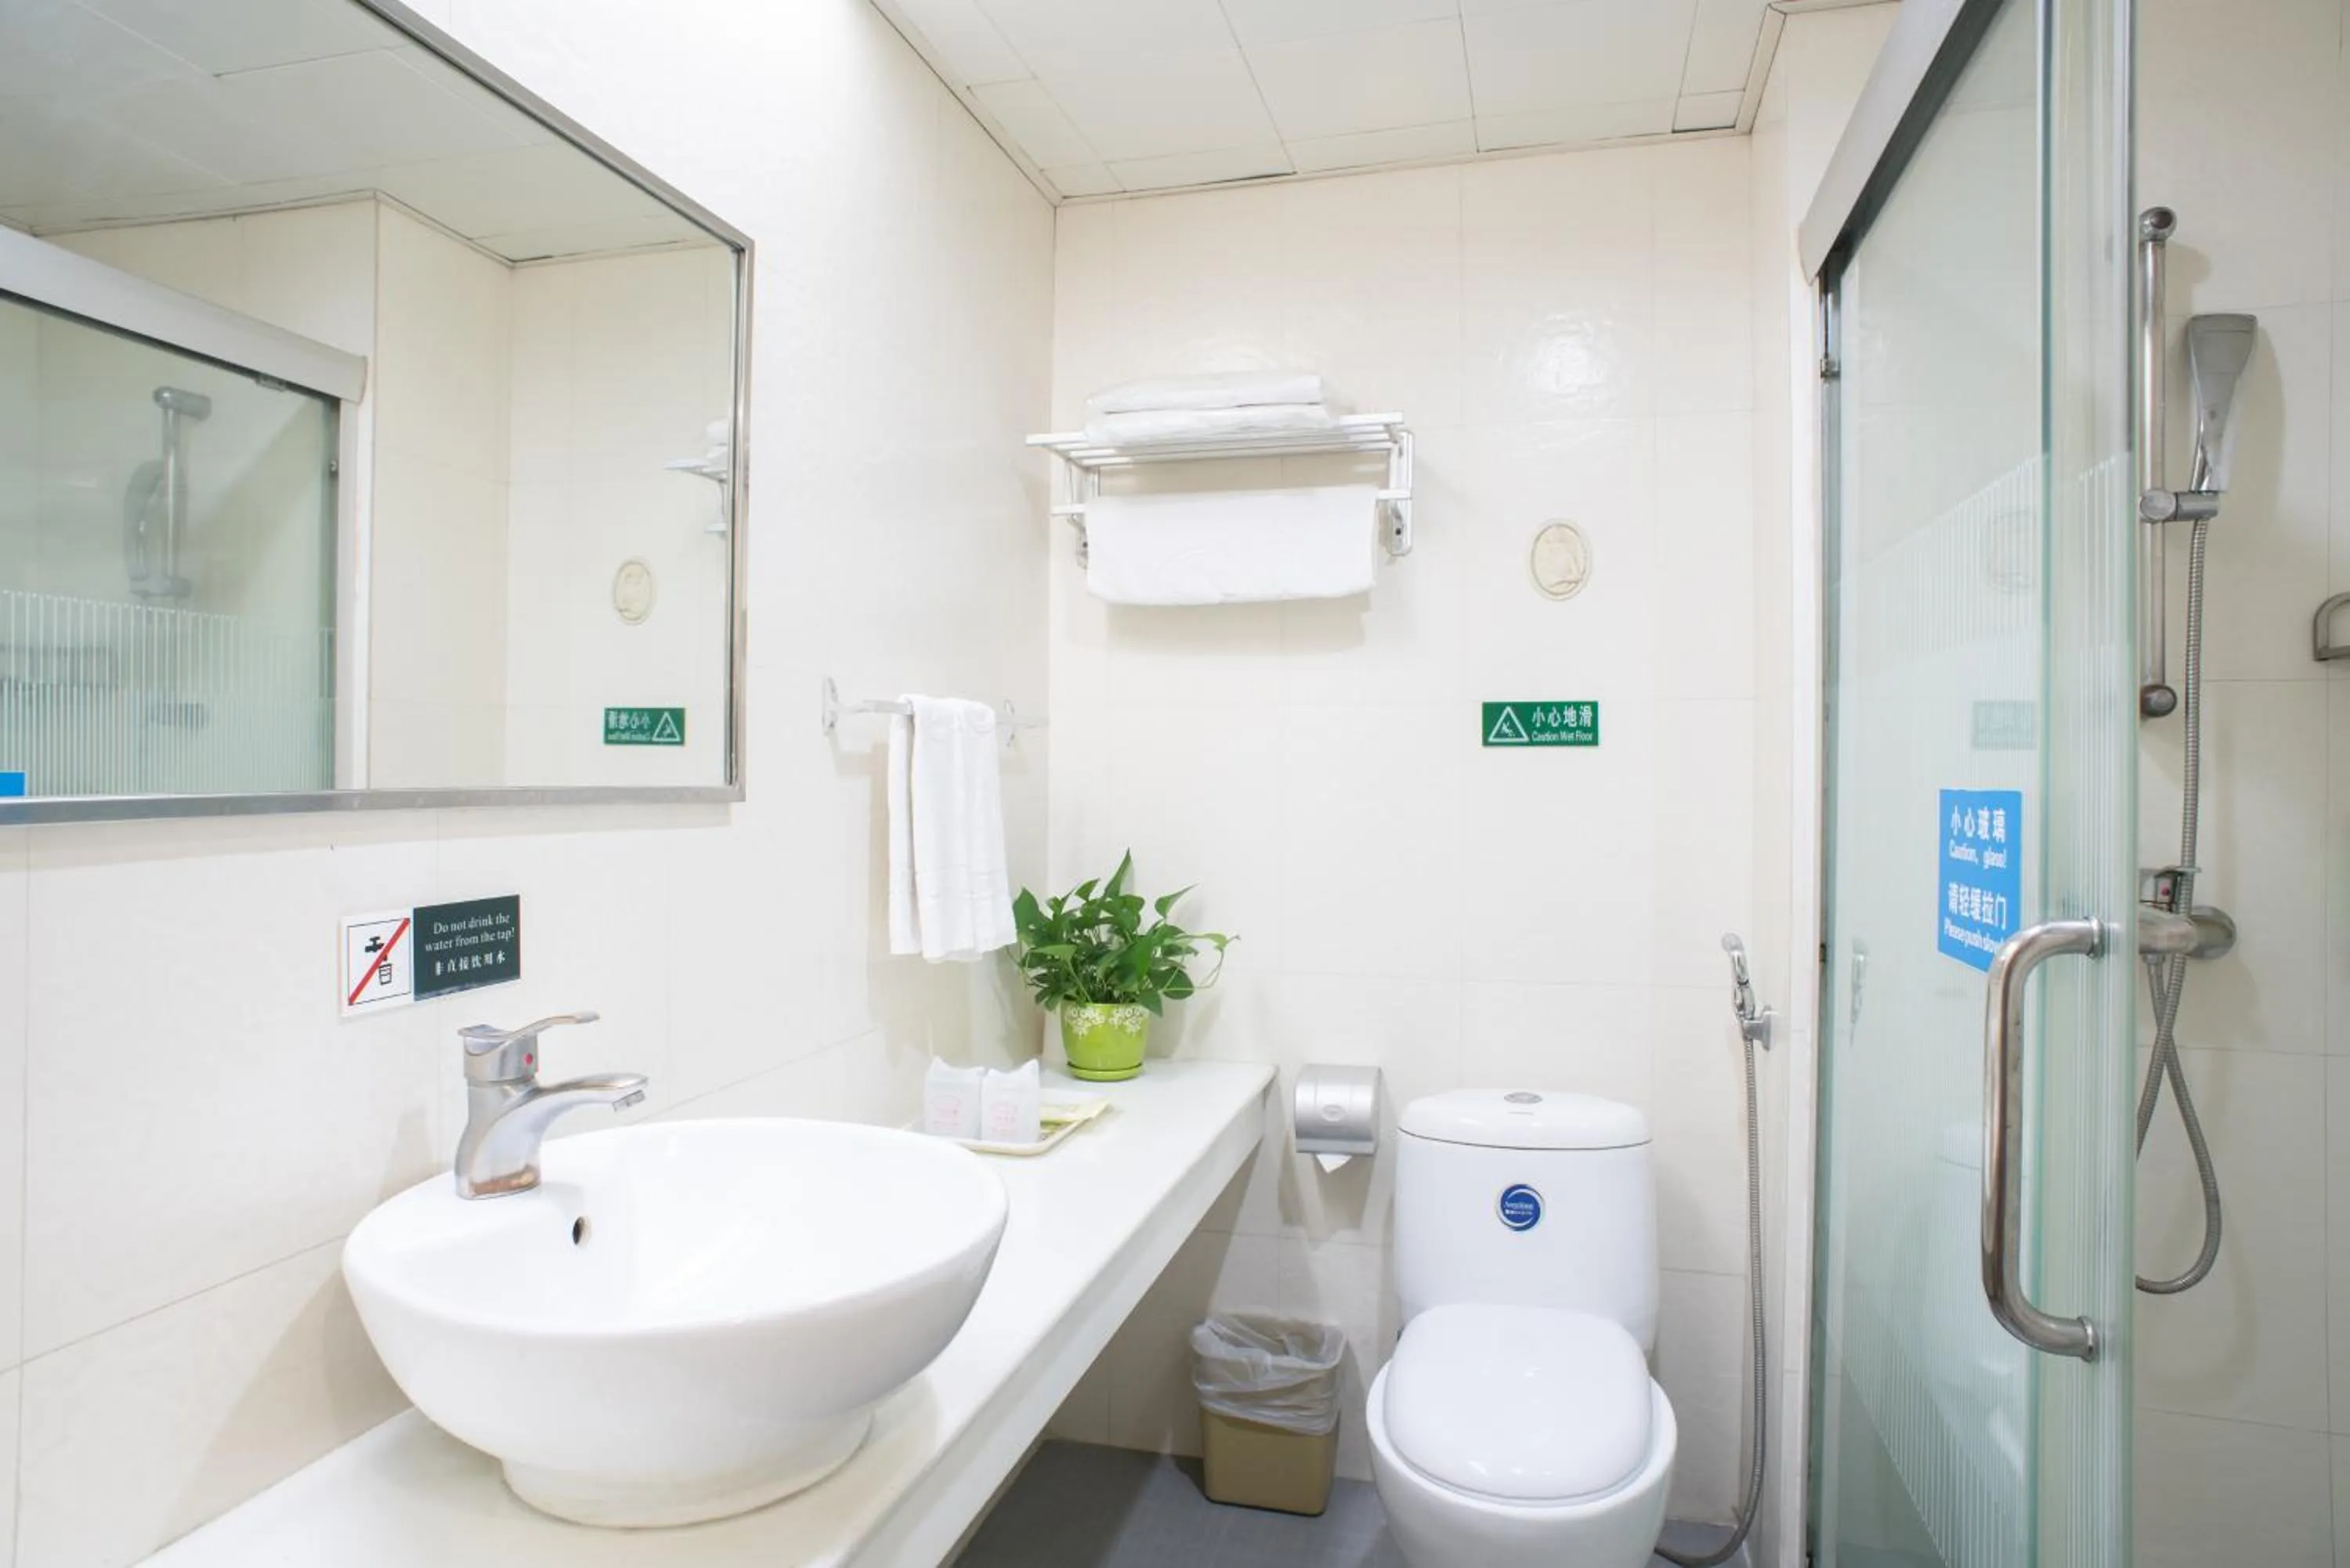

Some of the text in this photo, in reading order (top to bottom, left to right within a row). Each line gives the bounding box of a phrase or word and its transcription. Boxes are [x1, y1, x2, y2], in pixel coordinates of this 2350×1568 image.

[1531, 704, 1593, 728] 小心地滑
[1531, 730, 1560, 742] Caution
[1575, 730, 1593, 742] Floor
[1950, 805, 2006, 843] 小心玻璃
[1947, 881, 2006, 930] 请轻缓拉门
[433, 912, 511, 934] Do not drink the
[425, 927, 515, 952] water from the tap!
